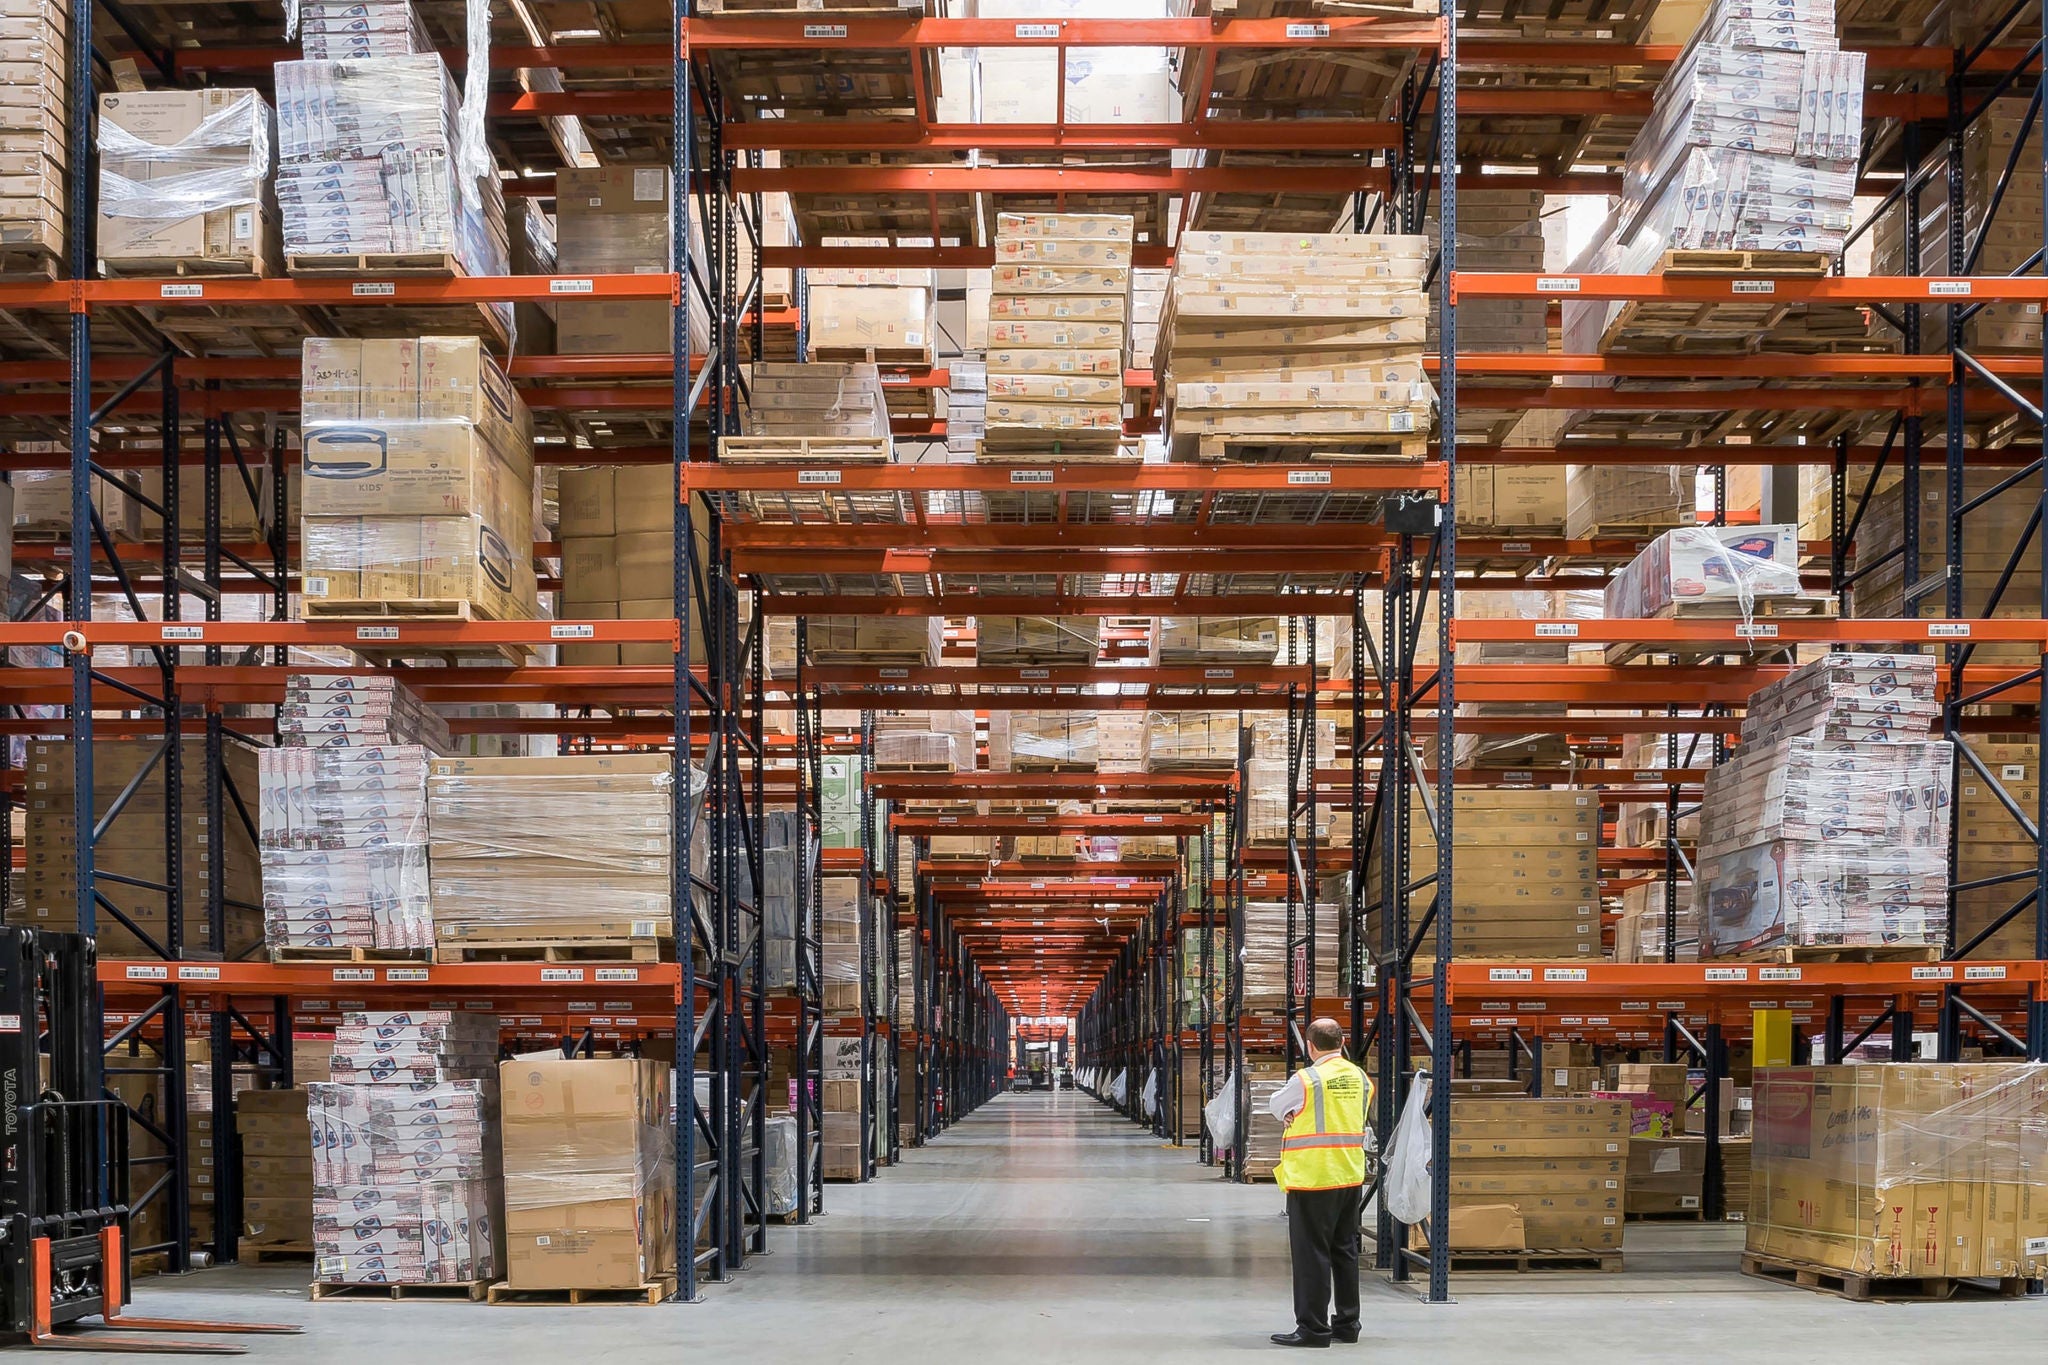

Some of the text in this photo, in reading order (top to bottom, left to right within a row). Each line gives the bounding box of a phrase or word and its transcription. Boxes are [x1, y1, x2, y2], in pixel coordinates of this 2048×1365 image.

[1911, 656, 1934, 665] MARVEL
[369, 677, 392, 687] MARVEL
[1912, 673, 1934, 683] MARVEL
[368, 691, 390, 701] MARVEL
[366, 705, 389, 715] MARVEL
[361, 719, 384, 729] MARVEL
[1907, 715, 1929, 725] MARVEL
[365, 733, 386, 743] MARVEL
[399, 746, 420, 756] MARVEL
[345, 907, 368, 916] MARVEL
[347, 921, 370, 930] MARVEL
[347, 935, 370, 944] MARVEL
[427, 1011, 448, 1021] MARVEL
[411, 1056, 433, 1064] MARVEL
[6, 1068, 17, 1136] TOYOTA
[452, 1095, 473, 1104] MARVEL
[453, 1110, 475, 1119] MARVEL
[398, 1242, 421, 1252] MARVEL
[400, 1257, 422, 1266] MARVEL
[402, 1270, 425, 1280] MARVEL
